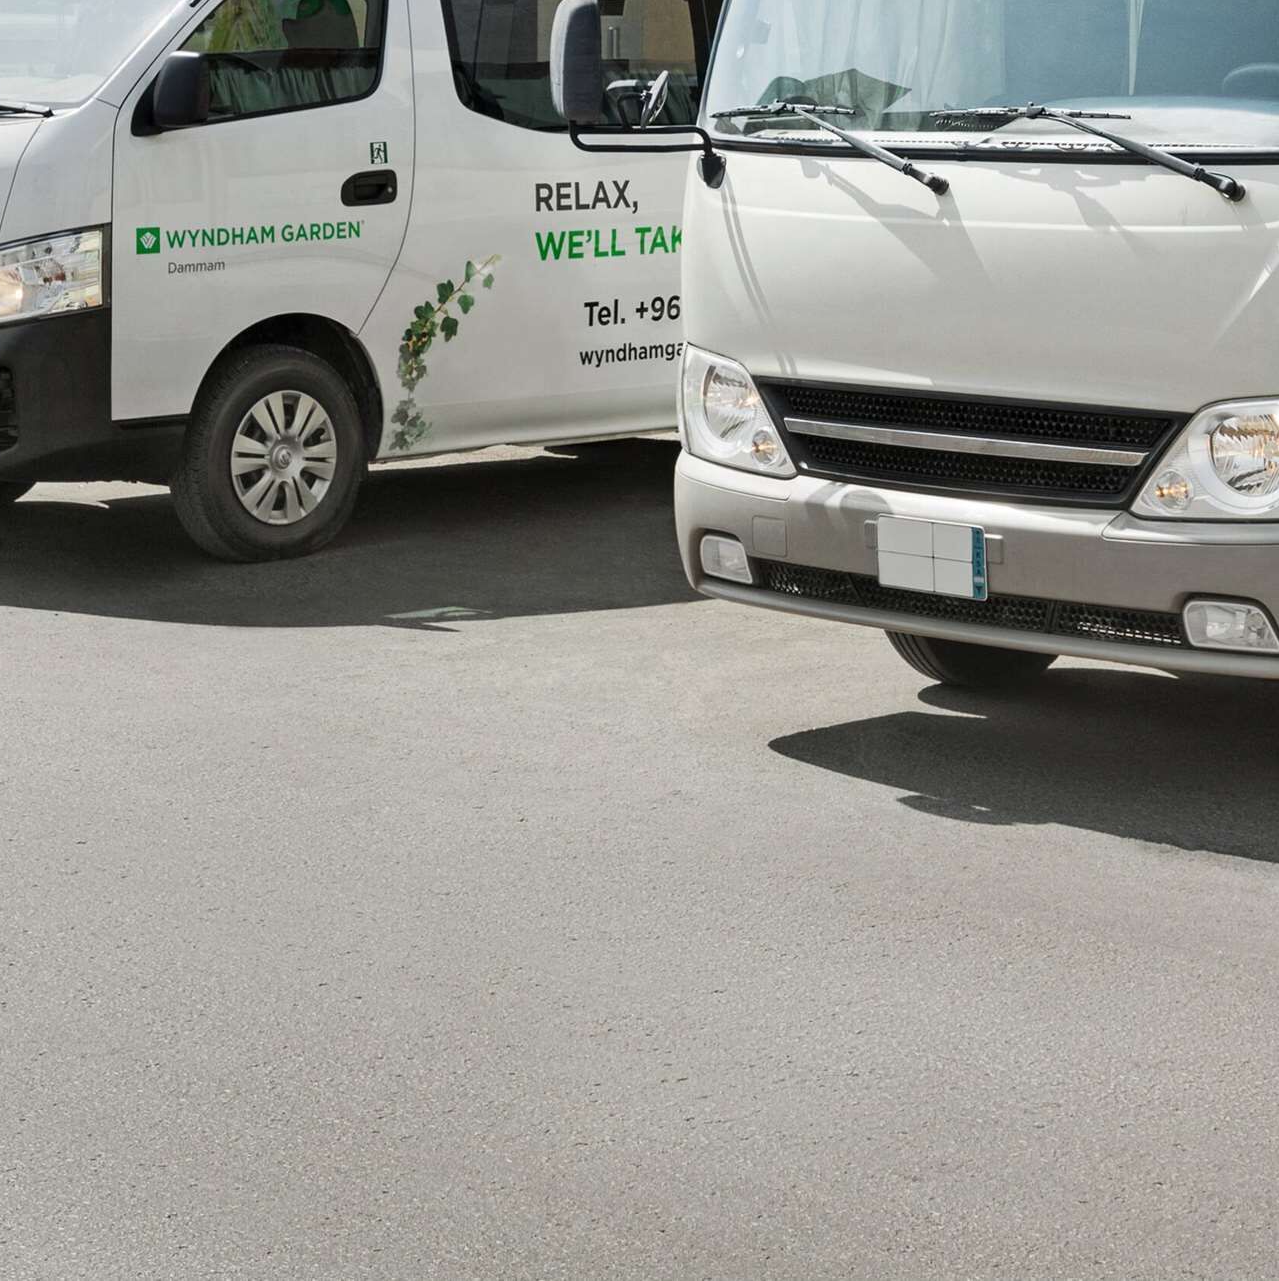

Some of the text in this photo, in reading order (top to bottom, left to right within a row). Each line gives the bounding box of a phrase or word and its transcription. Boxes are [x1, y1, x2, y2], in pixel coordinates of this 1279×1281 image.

[535, 180, 639, 214] RELAX,
[166, 221, 361, 250] WYNDHAM GARDEN
[535, 228, 626, 262] WE'LL
[167, 260, 226, 275] Dammam
[584, 298, 626, 328] Tel.
